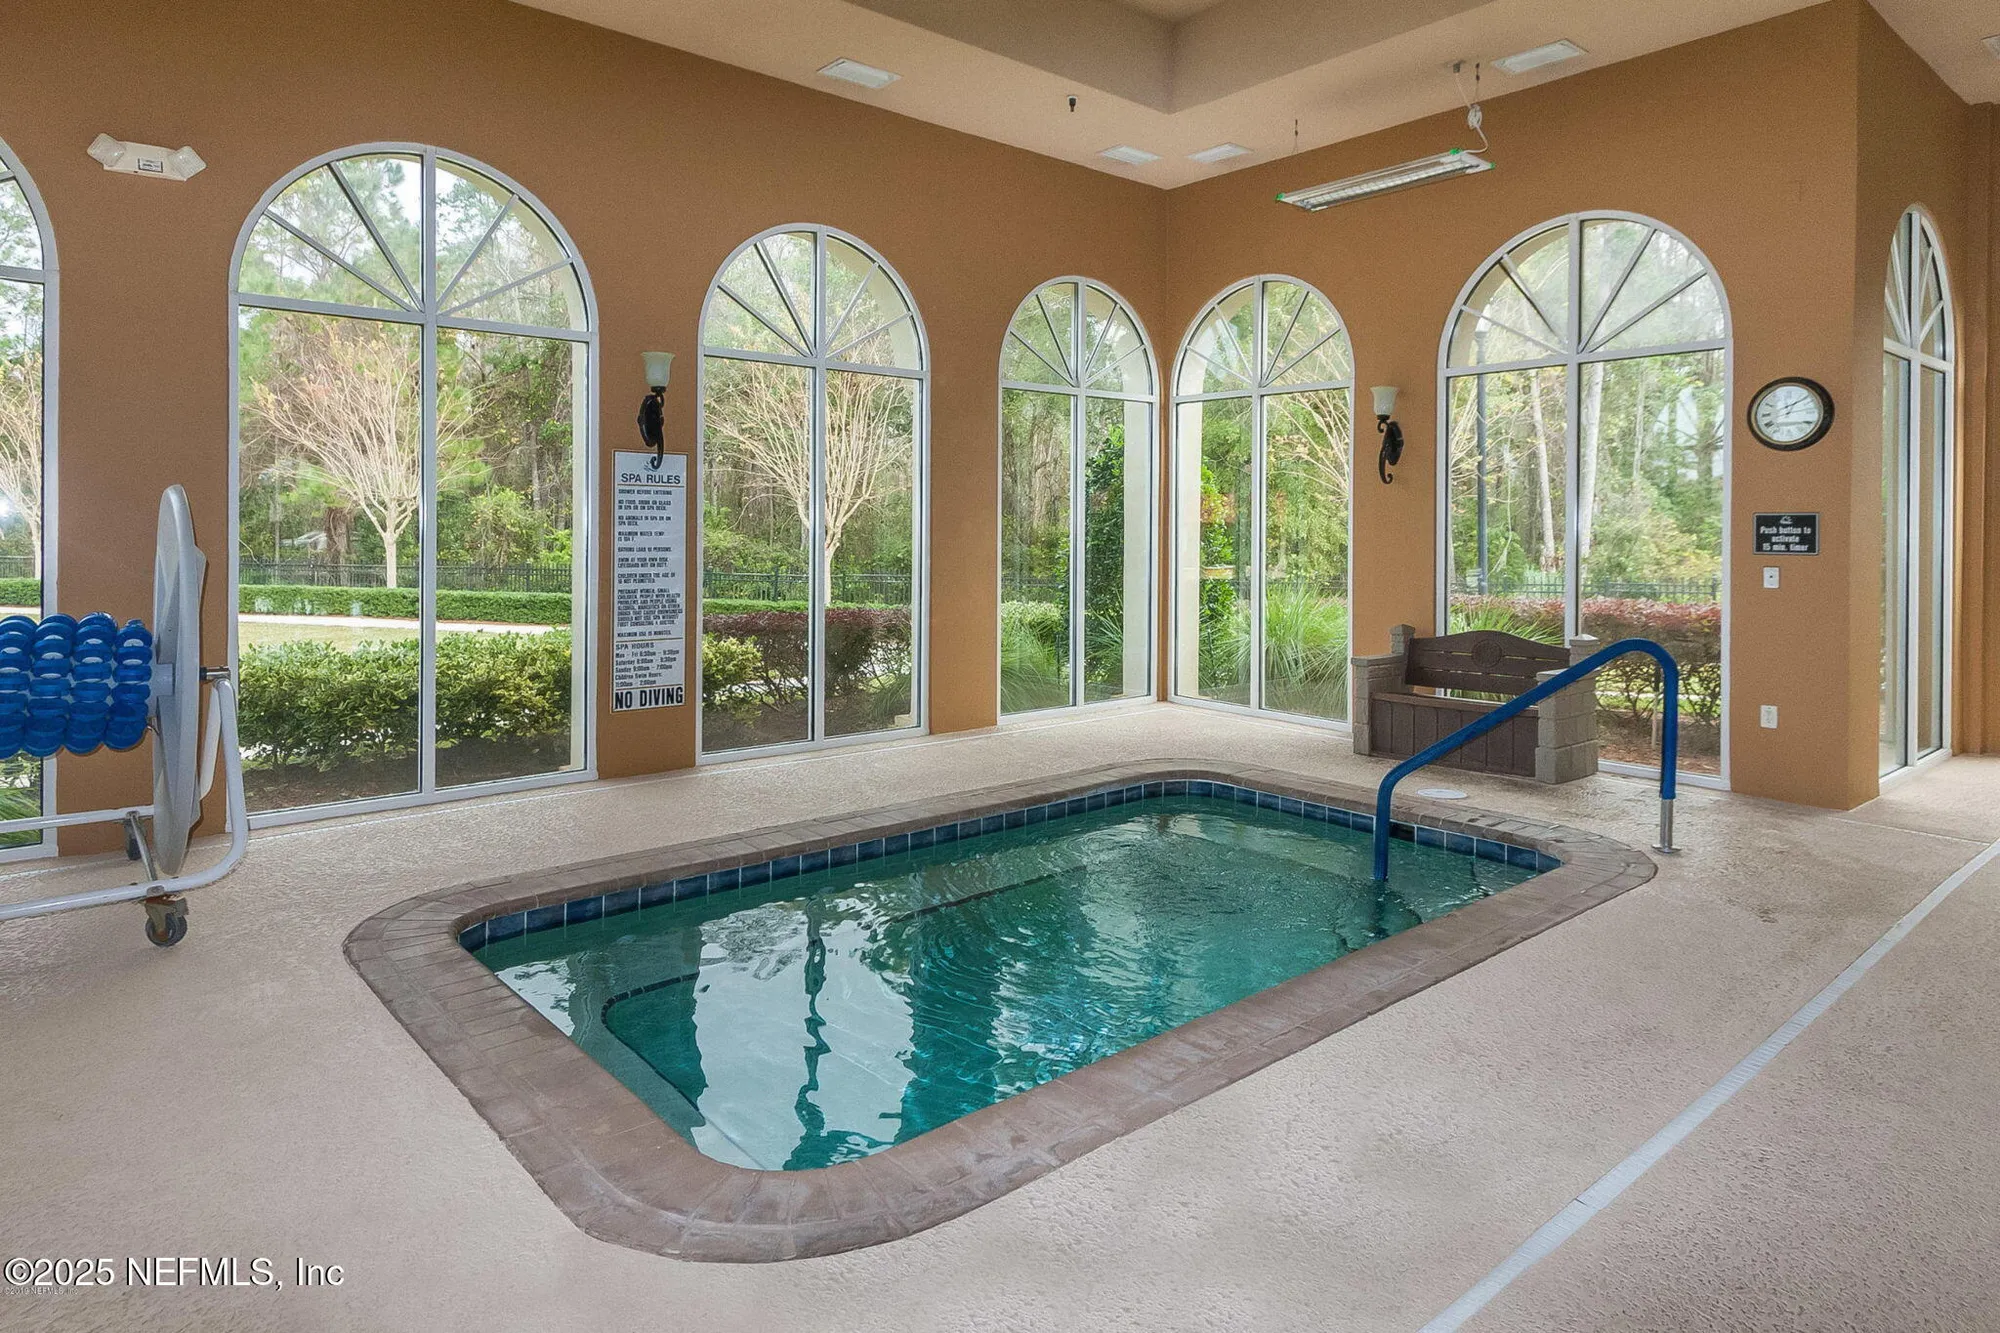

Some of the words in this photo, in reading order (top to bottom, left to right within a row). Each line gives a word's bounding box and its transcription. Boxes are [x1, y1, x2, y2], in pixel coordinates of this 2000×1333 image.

[621, 473, 641, 483] SPA
[646, 474, 680, 484] RULES
[615, 691, 632, 709] NO
[640, 687, 683, 707] DIVING
